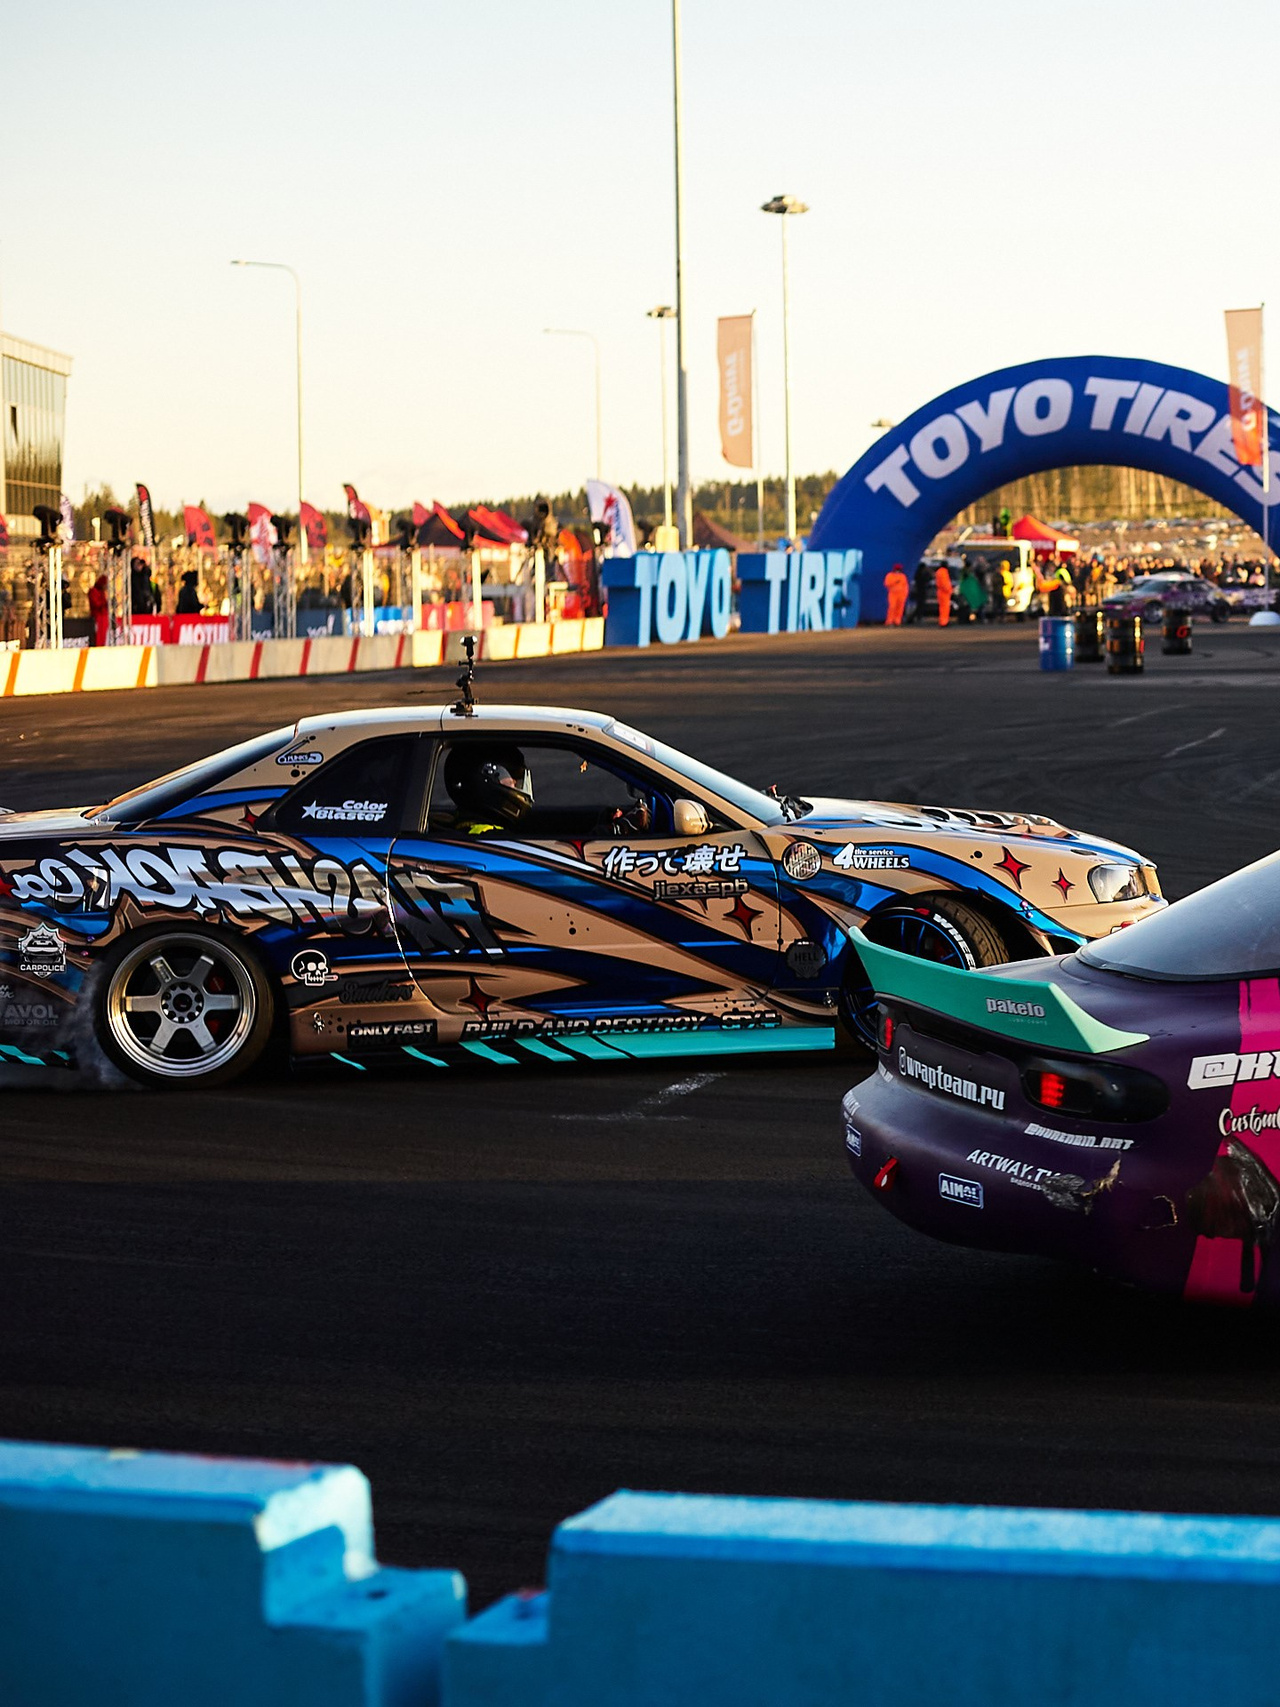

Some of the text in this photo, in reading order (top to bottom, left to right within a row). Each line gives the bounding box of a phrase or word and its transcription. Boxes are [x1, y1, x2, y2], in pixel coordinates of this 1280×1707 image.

[865, 378, 1073, 508] TOYO
[635, 549, 864, 647] TOYO TIRES
[179, 623, 230, 644] MOTU
[316, 809, 385, 821] Blaster
[342, 800, 388, 811] Color
[20, 964, 65, 972] CARPOLICE
[986, 998, 1045, 1018] pakelo
[351, 1023, 433, 1036] ONLY FAST
[465, 1020, 534, 1040] BUILD
[535, 1019, 590, 1037] AND
[591, 1015, 707, 1034] DESTROY
[899, 1046, 1006, 1110] @wrapteam.ru
